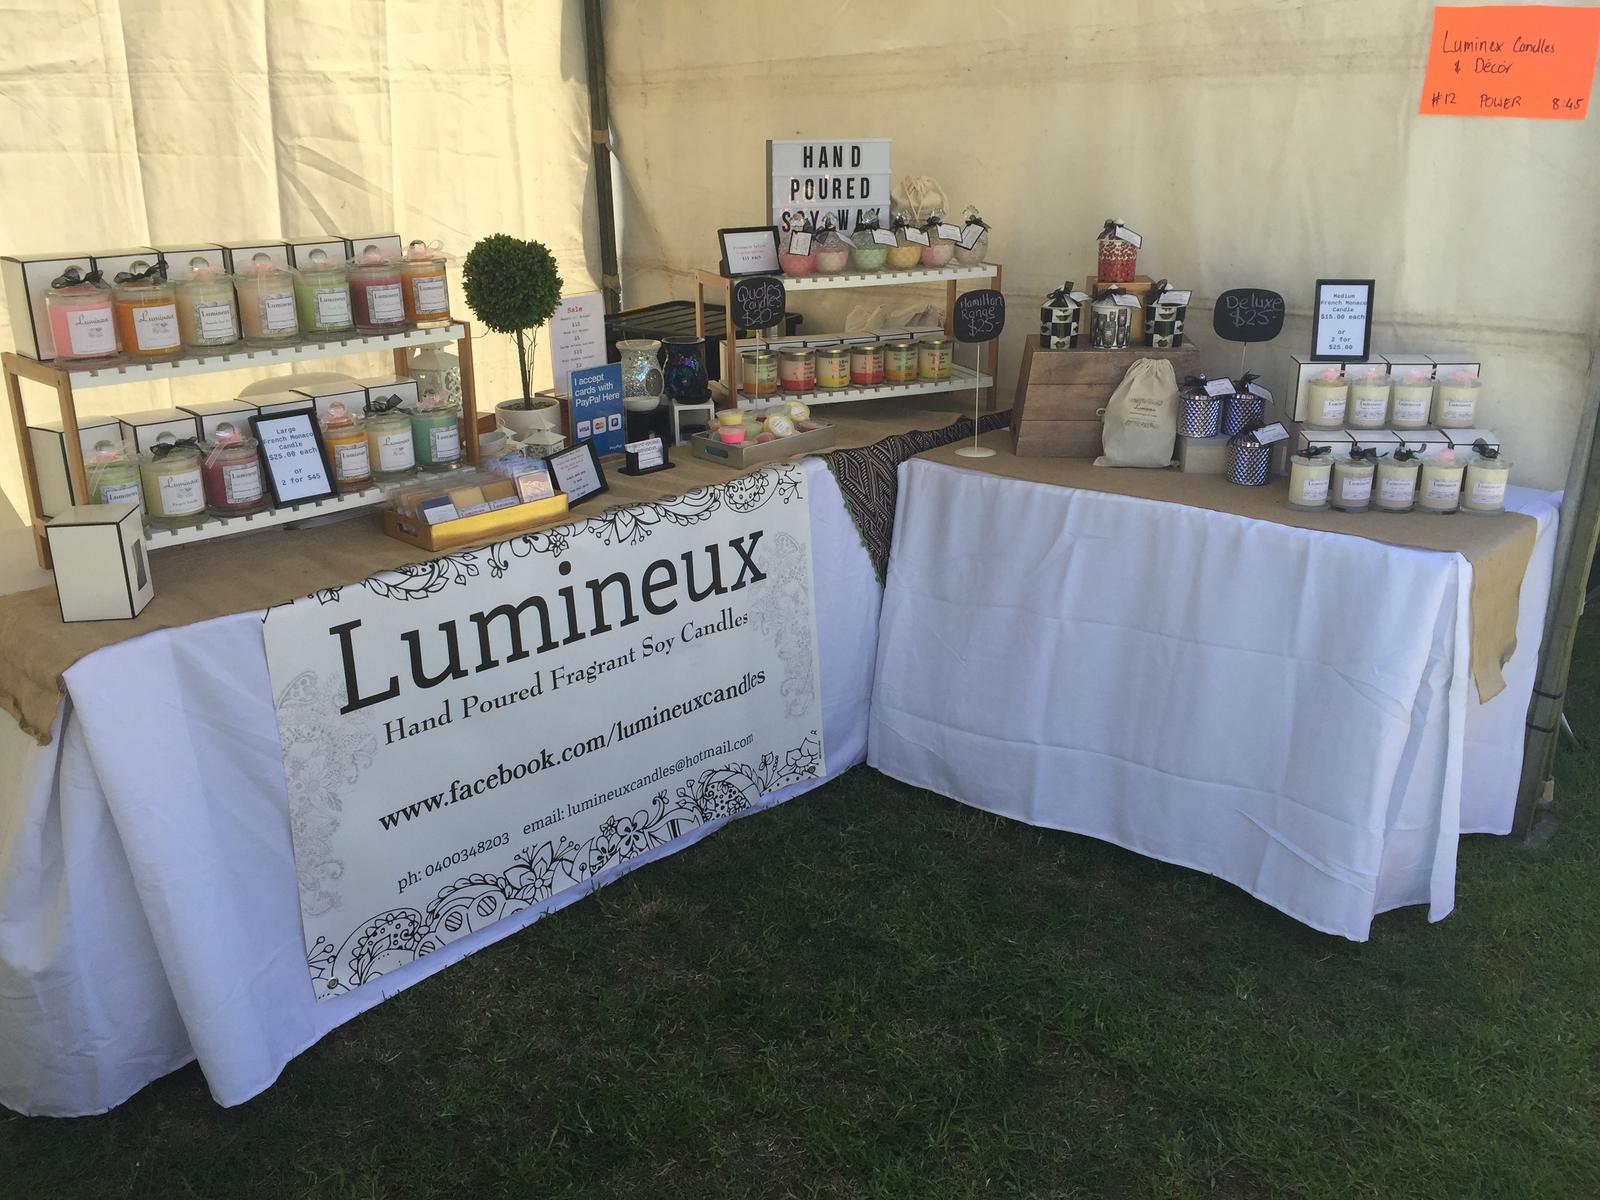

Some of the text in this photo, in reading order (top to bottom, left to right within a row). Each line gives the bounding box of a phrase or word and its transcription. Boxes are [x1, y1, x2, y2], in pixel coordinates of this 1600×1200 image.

[1442, 30, 1556, 54] Luminex Candles
[1431, 91, 1457, 107] #12
[1479, 93, 1522, 110] POWER
[803, 145, 861, 169] HAND
[790, 177, 870, 201] POURED
[567, 306, 583, 314] Sale
[961, 306, 996, 320] Range
[574, 373, 605, 386] I accept
[574, 381, 614, 397] cards with
[575, 392, 620, 408] PayPal Here
[276, 427, 296, 435] Large
[289, 432, 314, 440] Monaco
[278, 441, 303, 450] Candle
[268, 447, 318, 461] $25.00 each
[290, 476, 303, 484] for
[307, 472, 321, 481] $45
[294, 467, 303, 475] or
[329, 530, 767, 715] Lumineux
[383, 607, 748, 746] Hand Poured Fragrant Soy Candles
[379, 670, 766, 831] www.facebook.com/lumineuxcandles
[397, 731, 754, 895] ph: 0400348203 email: lumineuxcandles@hotmail.com
